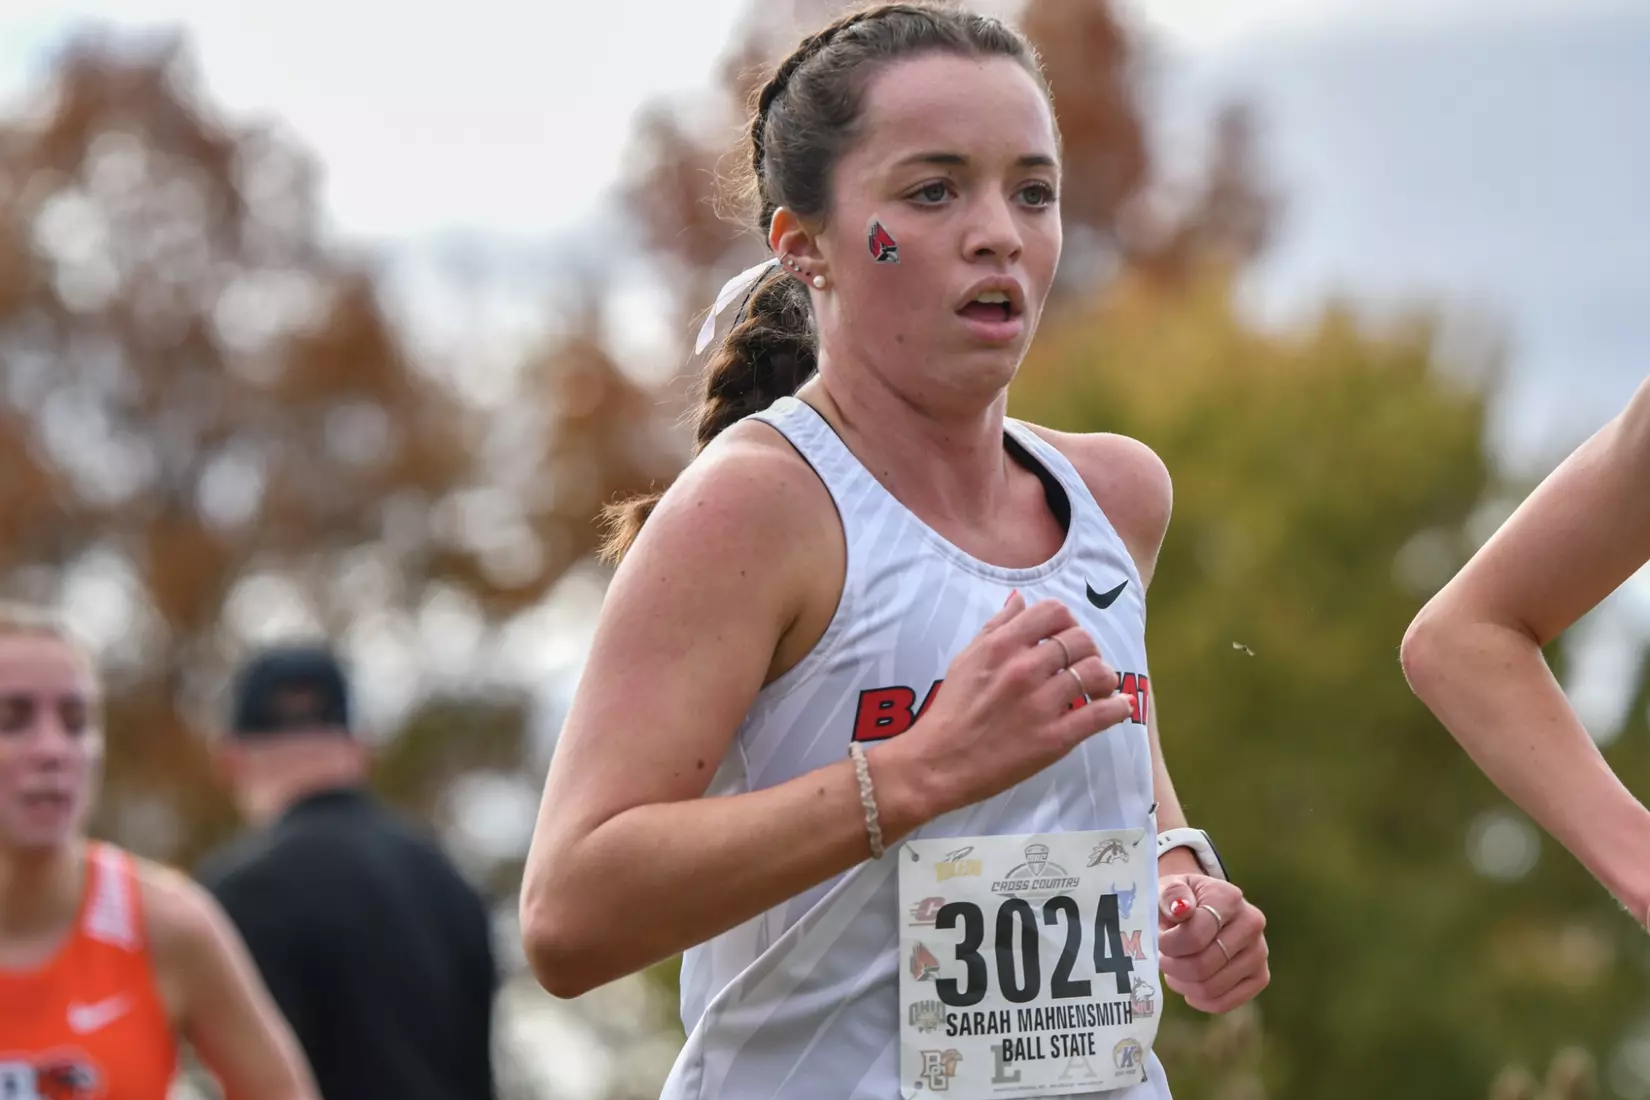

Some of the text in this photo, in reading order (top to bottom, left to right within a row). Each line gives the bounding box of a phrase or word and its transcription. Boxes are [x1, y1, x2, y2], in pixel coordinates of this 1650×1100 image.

[991, 877, 1080, 892] CROSS COUNTRY
[935, 893, 1134, 1007] 3024
[946, 1000, 1133, 1037] SARAH MAHNENSMITH
[1002, 1032, 1096, 1062] BALL STATE
